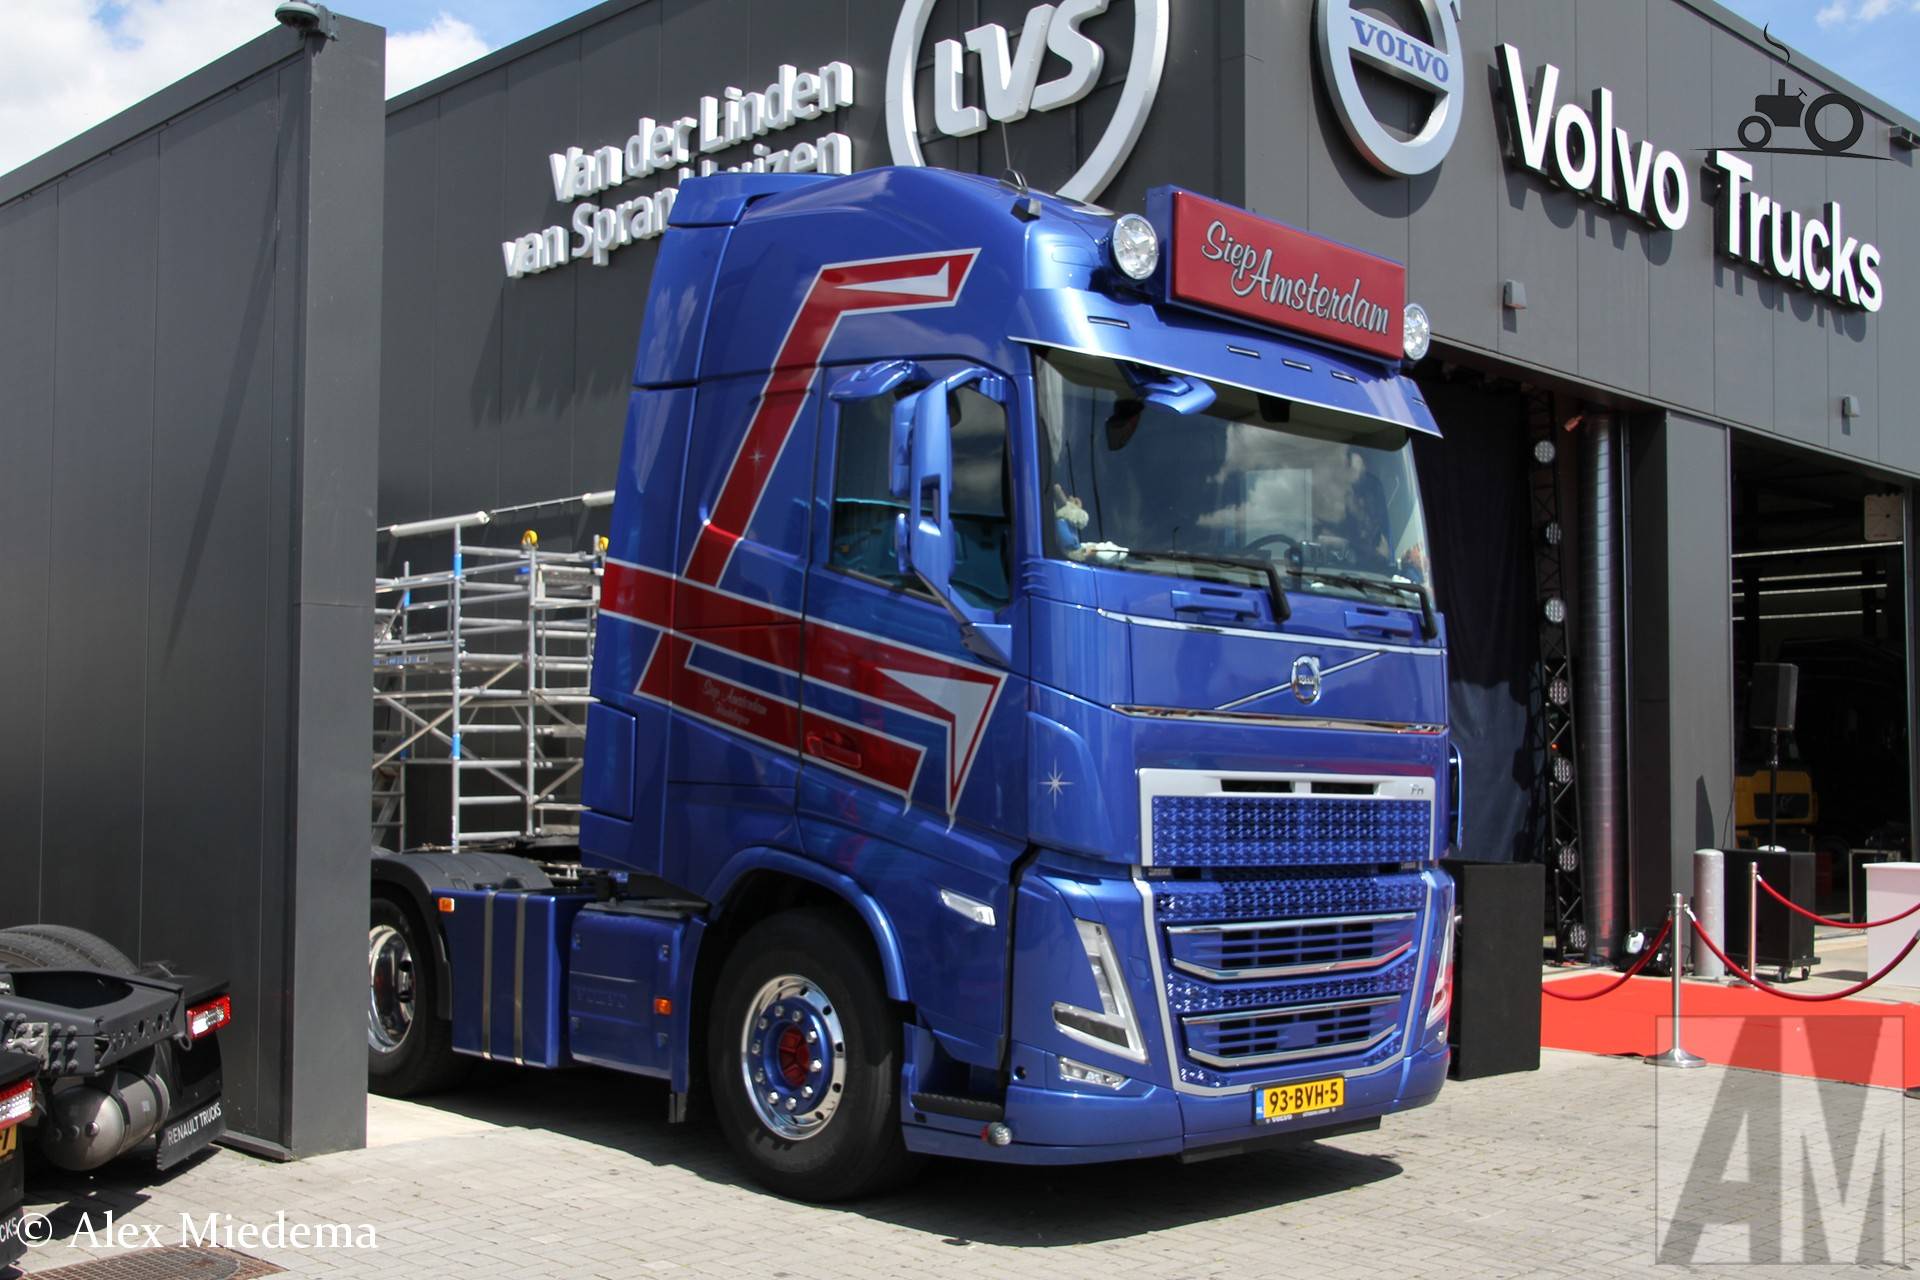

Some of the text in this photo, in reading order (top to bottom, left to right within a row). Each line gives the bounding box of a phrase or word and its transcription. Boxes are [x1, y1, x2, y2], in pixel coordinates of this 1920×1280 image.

[1350, 16, 1449, 83] VOLVO
[550, 61, 853, 202] Van der Linden
[1497, 43, 1883, 313] Volvo Trucks
[503, 225, 569, 279] van
[1201, 220, 1389, 334] Siep Amsterdam
[167, 1101, 222, 1147] RENAULT TRUCKS
[1269, 1081, 1339, 1113] 93-BVH-5
